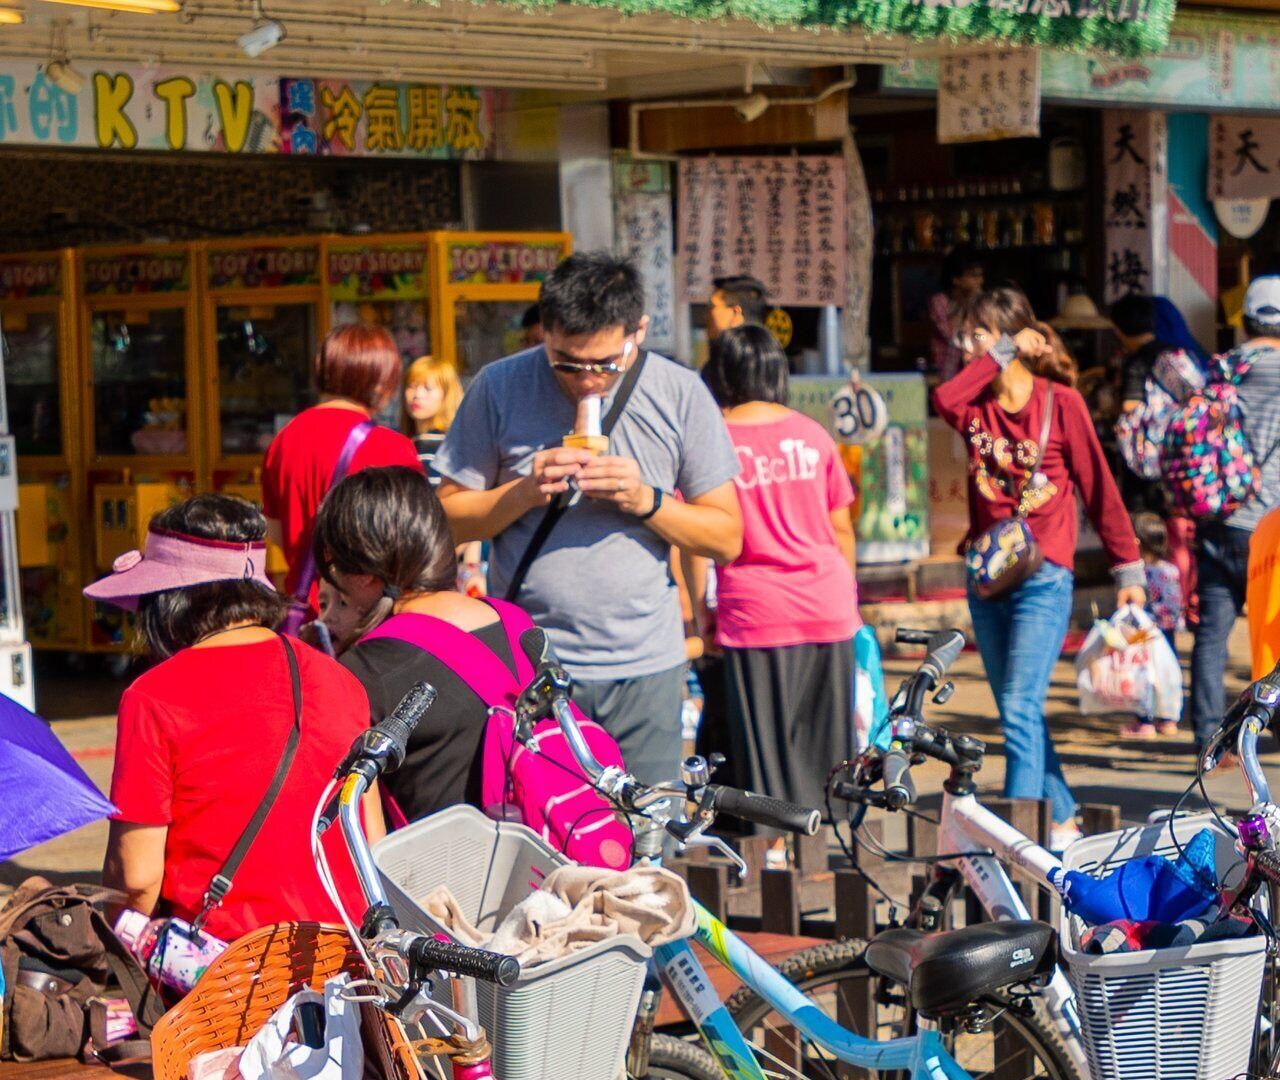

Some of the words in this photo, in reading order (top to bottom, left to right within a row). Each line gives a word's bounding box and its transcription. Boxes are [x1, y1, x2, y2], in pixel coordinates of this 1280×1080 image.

[92, 70, 256, 152] KTV
[320, 83, 486, 153] 冷氣開放
[833, 389, 877, 436] 30
